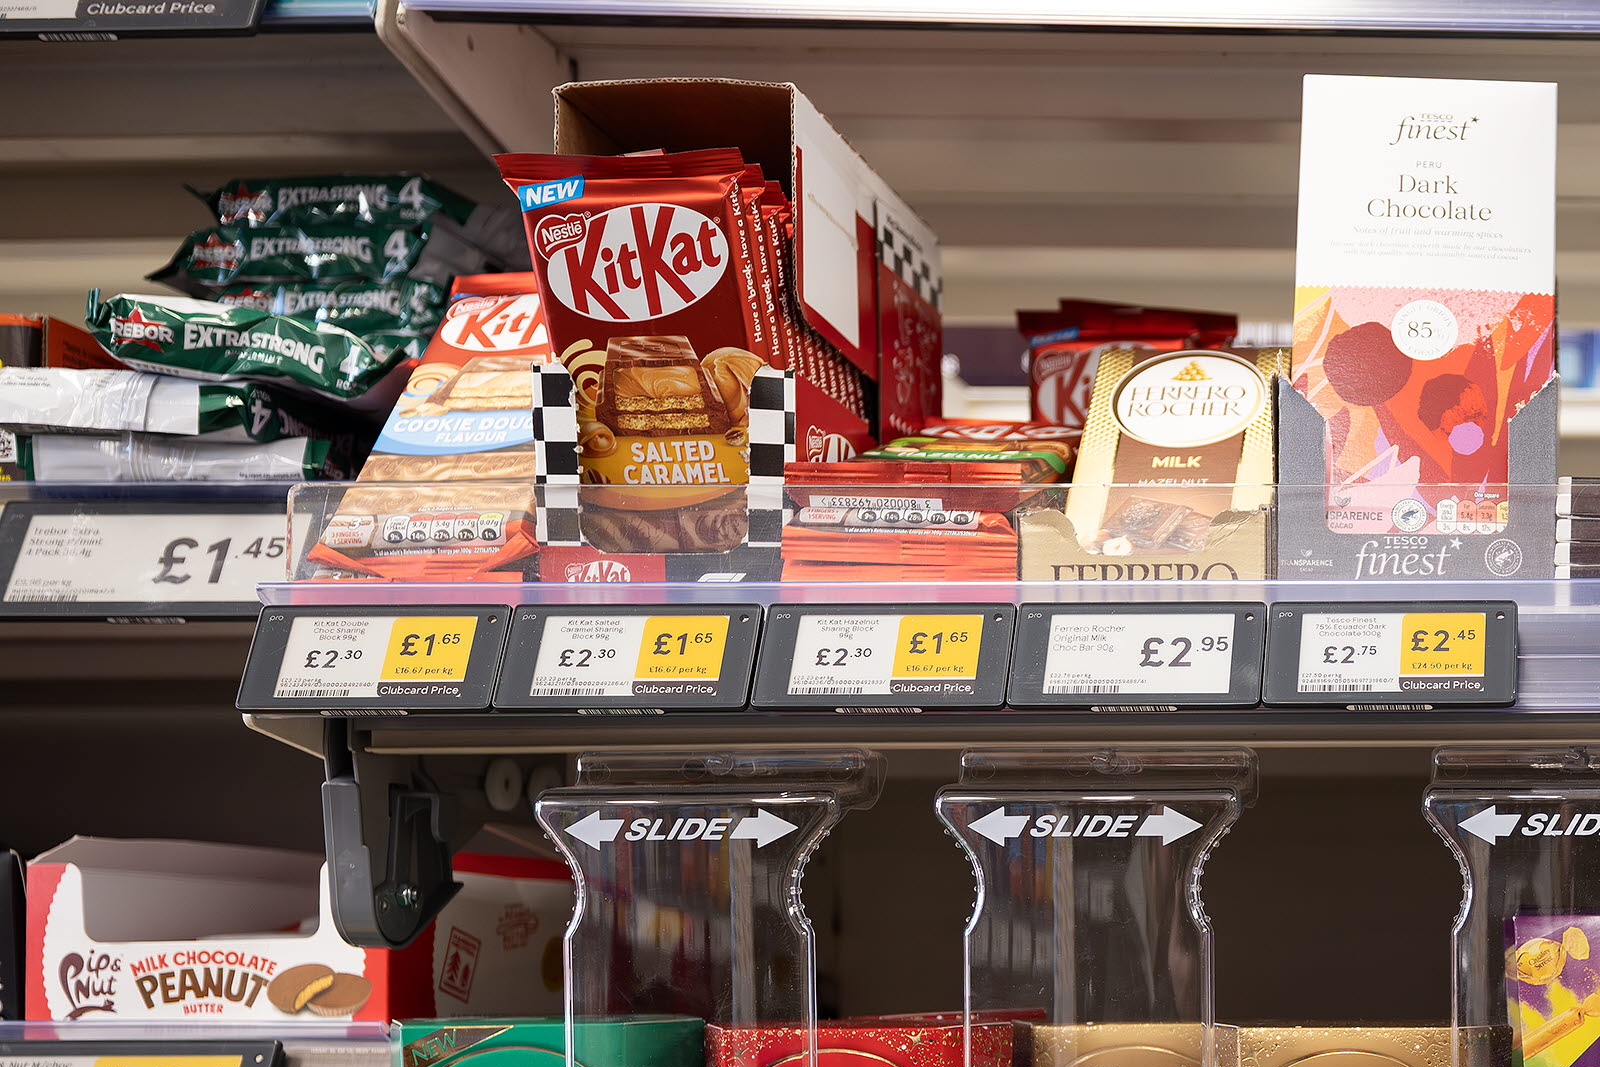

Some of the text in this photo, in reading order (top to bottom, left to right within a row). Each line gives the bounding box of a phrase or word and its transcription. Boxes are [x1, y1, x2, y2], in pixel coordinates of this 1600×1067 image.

[1390, 116, 1471, 145] finest
[526, 180, 580, 209] NEW
[1398, 174, 1459, 194] Dark
[1367, 198, 1491, 221] Chocolate
[564, 205, 721, 320] KitKat
[1130, 385, 1247, 402] FERRERO
[1127, 401, 1239, 418] ROCHER
[393, 416, 474, 434] COOKIE
[434, 431, 507, 442] FLAVOUR
[630, 440, 715, 463] SALTED
[1151, 455, 1202, 469] MILK
[623, 461, 730, 485] CARAMEL
[1383, 536, 1429, 546] TESCO
[152, 536, 286, 584] £1.45
[1355, 543, 1447, 580] finest
[1054, 634, 1107, 642] Original Milk
[1092, 624, 1126, 632] Rocher
[400, 633, 461, 657] £1.65
[1096, 644, 1114, 652] 90g
[1140, 636, 1229, 668] £2.95
[304, 650, 363, 669] £2.30
[625, 818, 732, 841] SLIDE
[1030, 815, 1138, 838] SLIDE
[130, 951, 278, 978] MILK CHOCOLATE
[135, 968, 270, 1009] PEANUT
[183, 1004, 224, 1015] BUTTER
